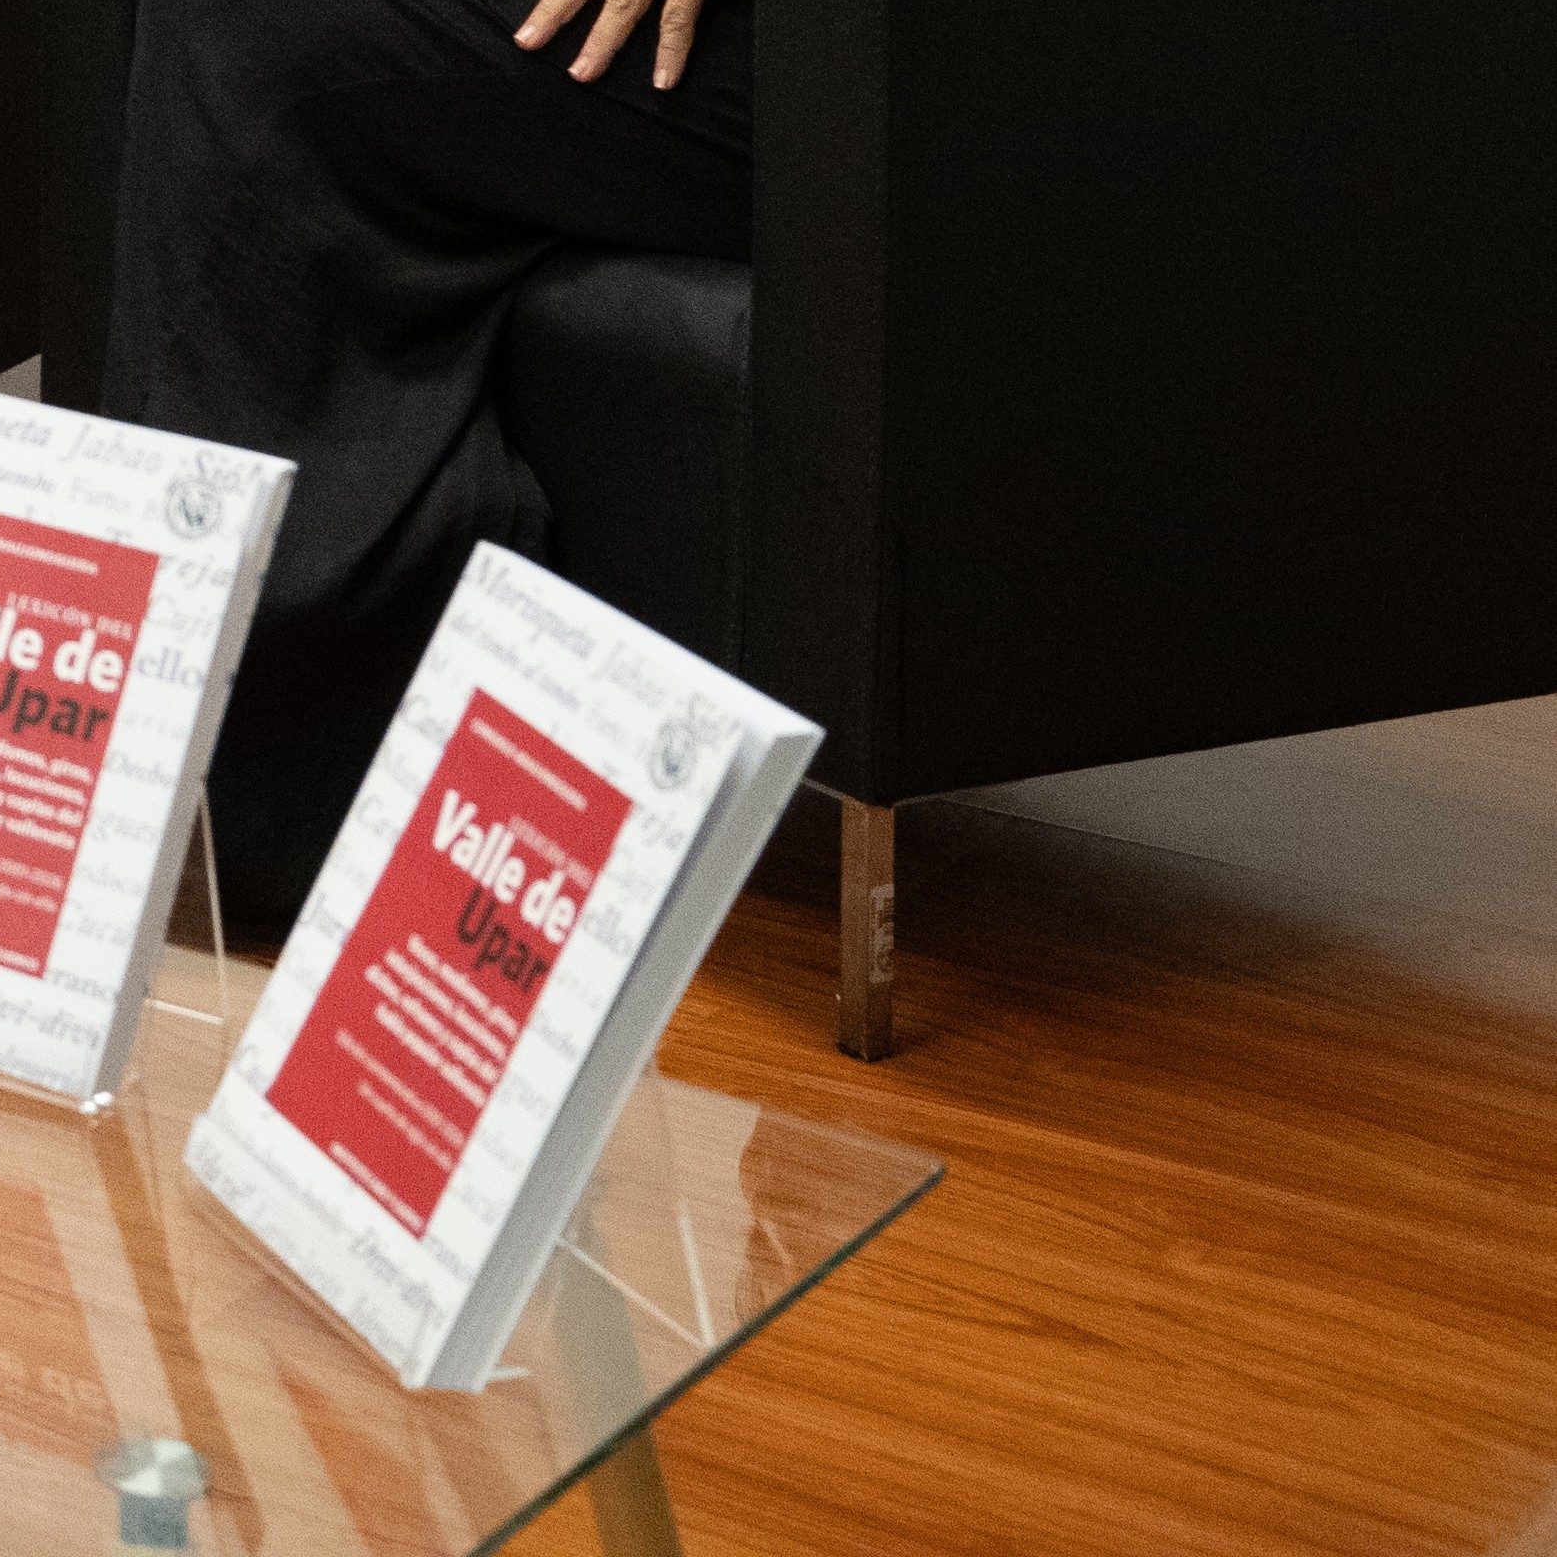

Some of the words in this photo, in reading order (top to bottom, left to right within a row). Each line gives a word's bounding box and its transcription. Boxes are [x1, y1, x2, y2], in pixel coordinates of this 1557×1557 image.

[53, 629, 126, 694] de
[433, 790, 526, 905] Valle
[523, 868, 577, 945] de
[457, 889, 551, 994] Upar
